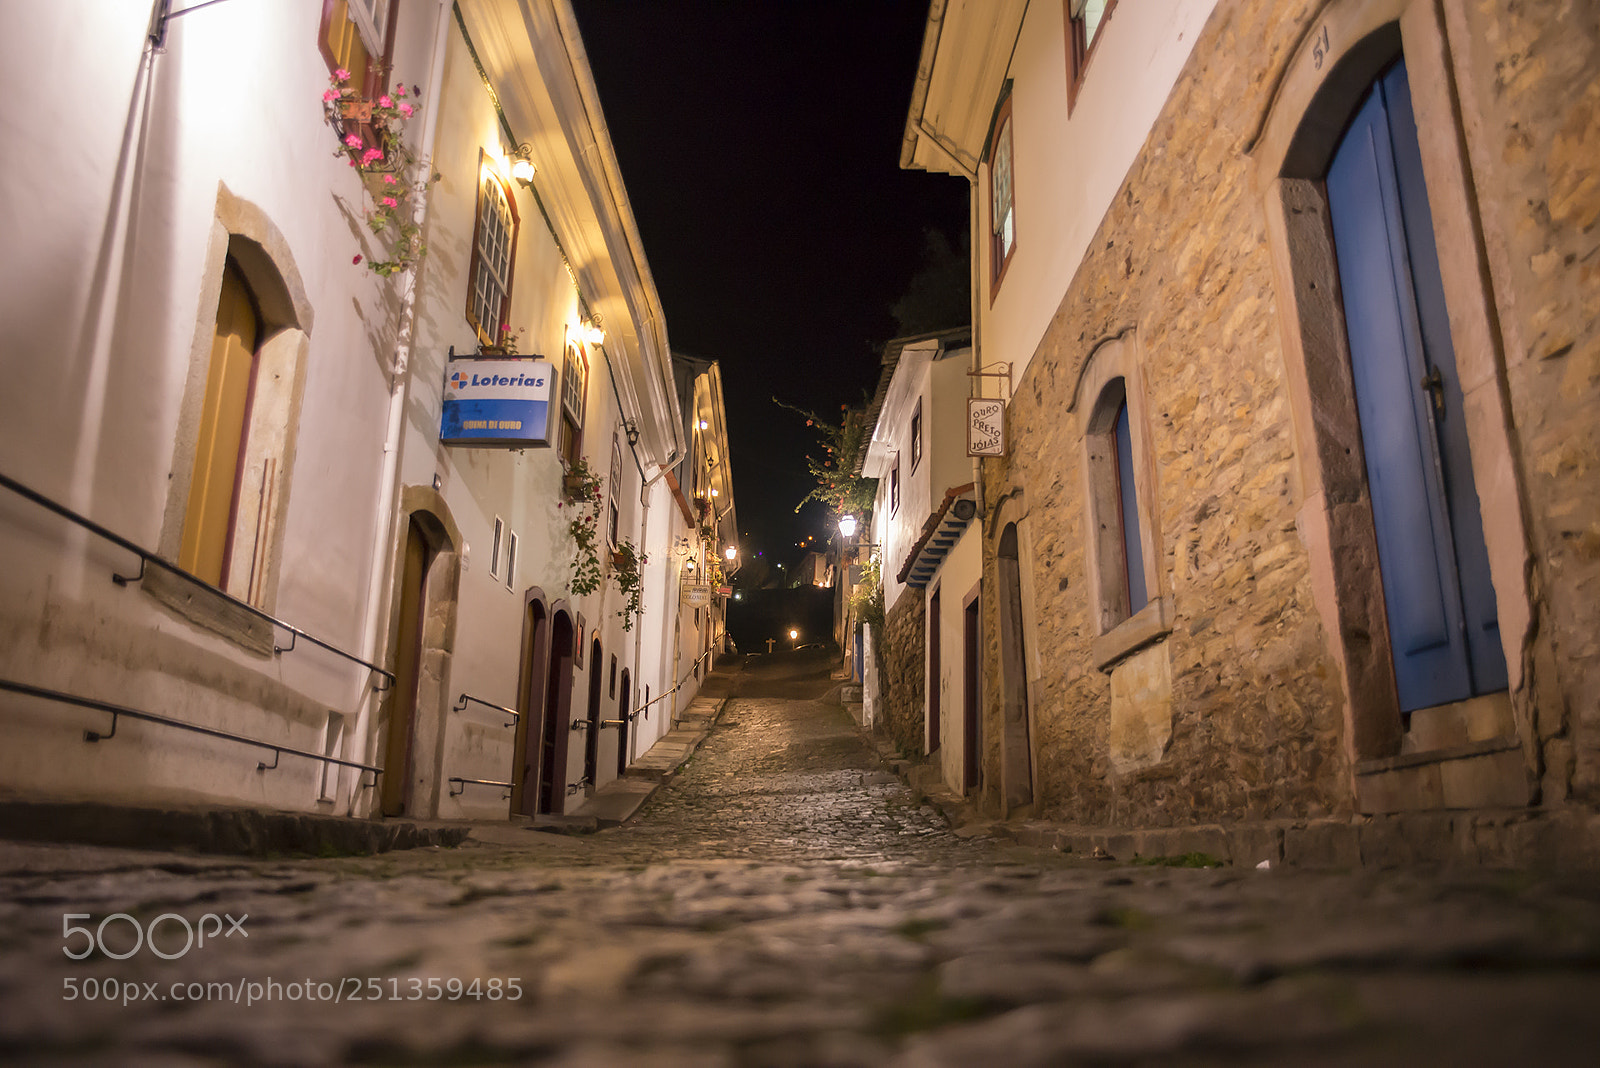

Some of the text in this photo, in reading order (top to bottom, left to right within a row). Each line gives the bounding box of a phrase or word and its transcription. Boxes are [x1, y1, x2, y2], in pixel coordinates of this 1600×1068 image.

[471, 373, 544, 387] Loterias
[973, 405, 999, 418] OURO
[463, 420, 487, 430] QUINA
[499, 420, 522, 430] OURO
[973, 419, 1001, 437] PRETO
[972, 436, 999, 449] JÓIAS
